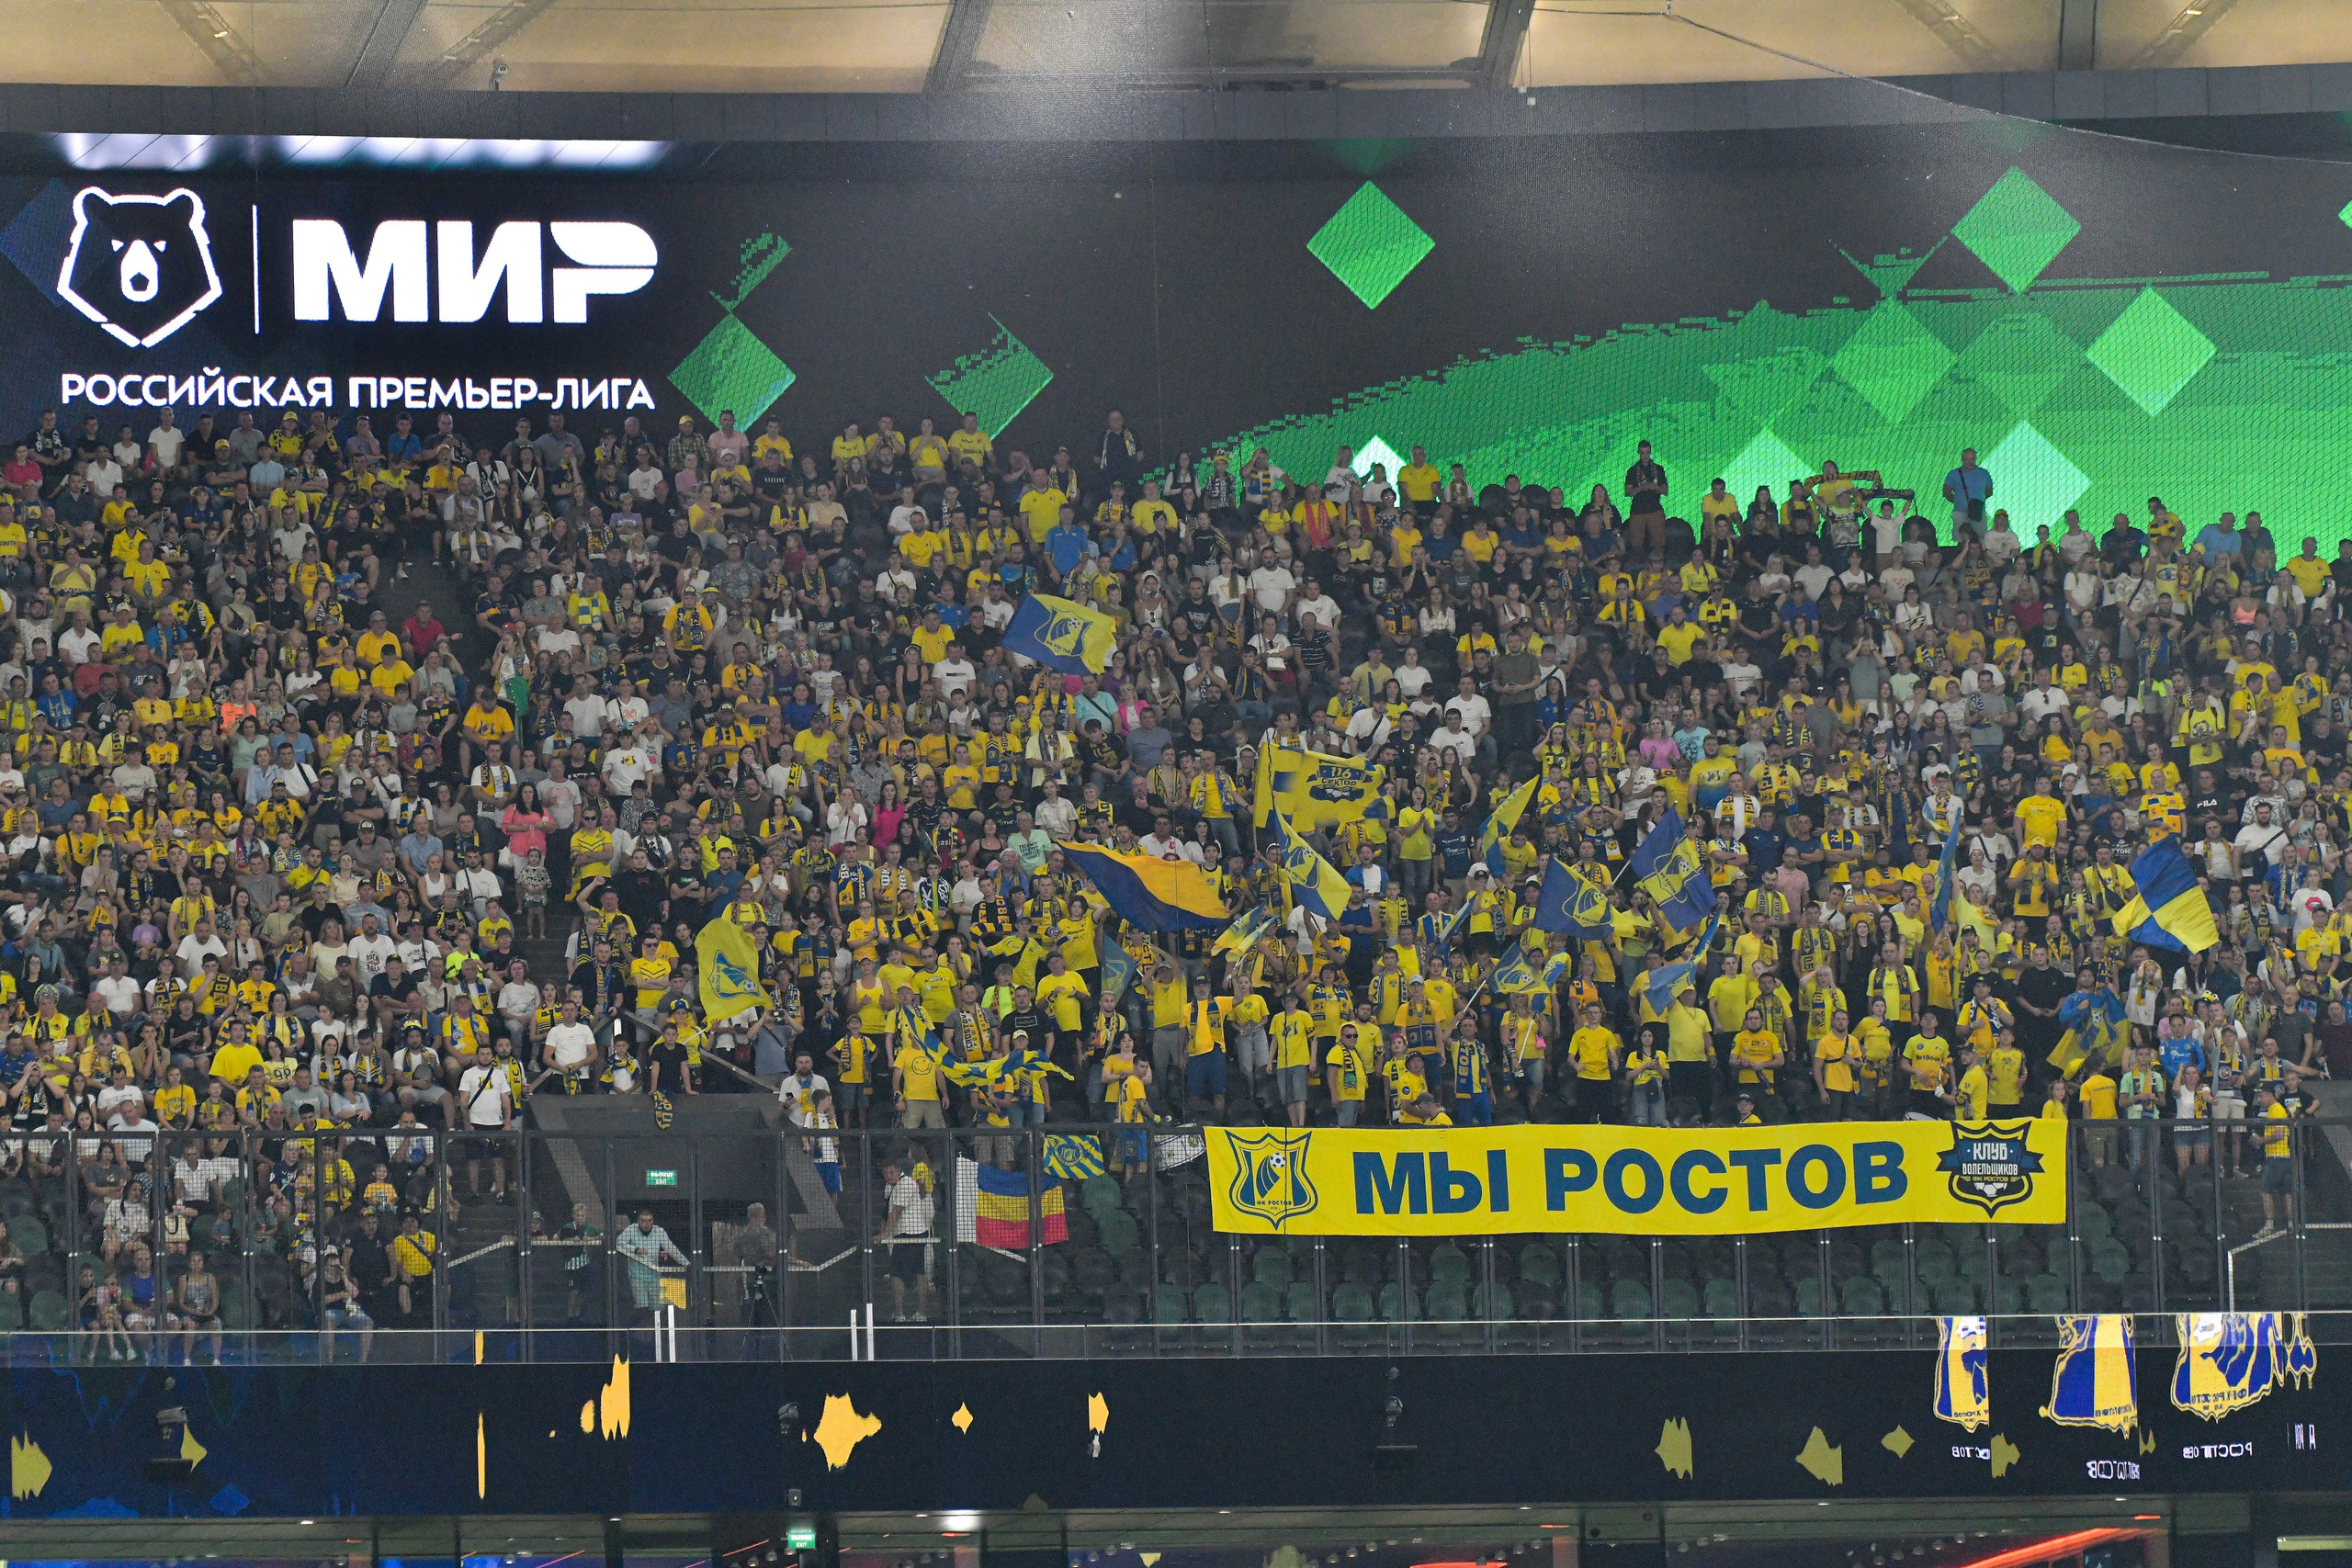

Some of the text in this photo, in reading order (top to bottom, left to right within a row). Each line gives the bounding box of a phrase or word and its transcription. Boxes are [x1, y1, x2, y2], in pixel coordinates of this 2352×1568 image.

[292, 219, 658, 323] МИР
[62, 367, 655, 410] РОССИЙСКАЯ ПРЕМЬЕР-ЛИГА
[1330, 766, 1352, 778] 116
[2196, 798, 2217, 808] FILA
[366, 953, 379, 962] ROCK
[1973, 1142, 2008, 1160] КЛУБ
[1962, 1163, 2018, 1176] БОЛЕЛЬЩИКОВ
[1353, 1141, 1908, 1214] МЫ РОСТОВ
